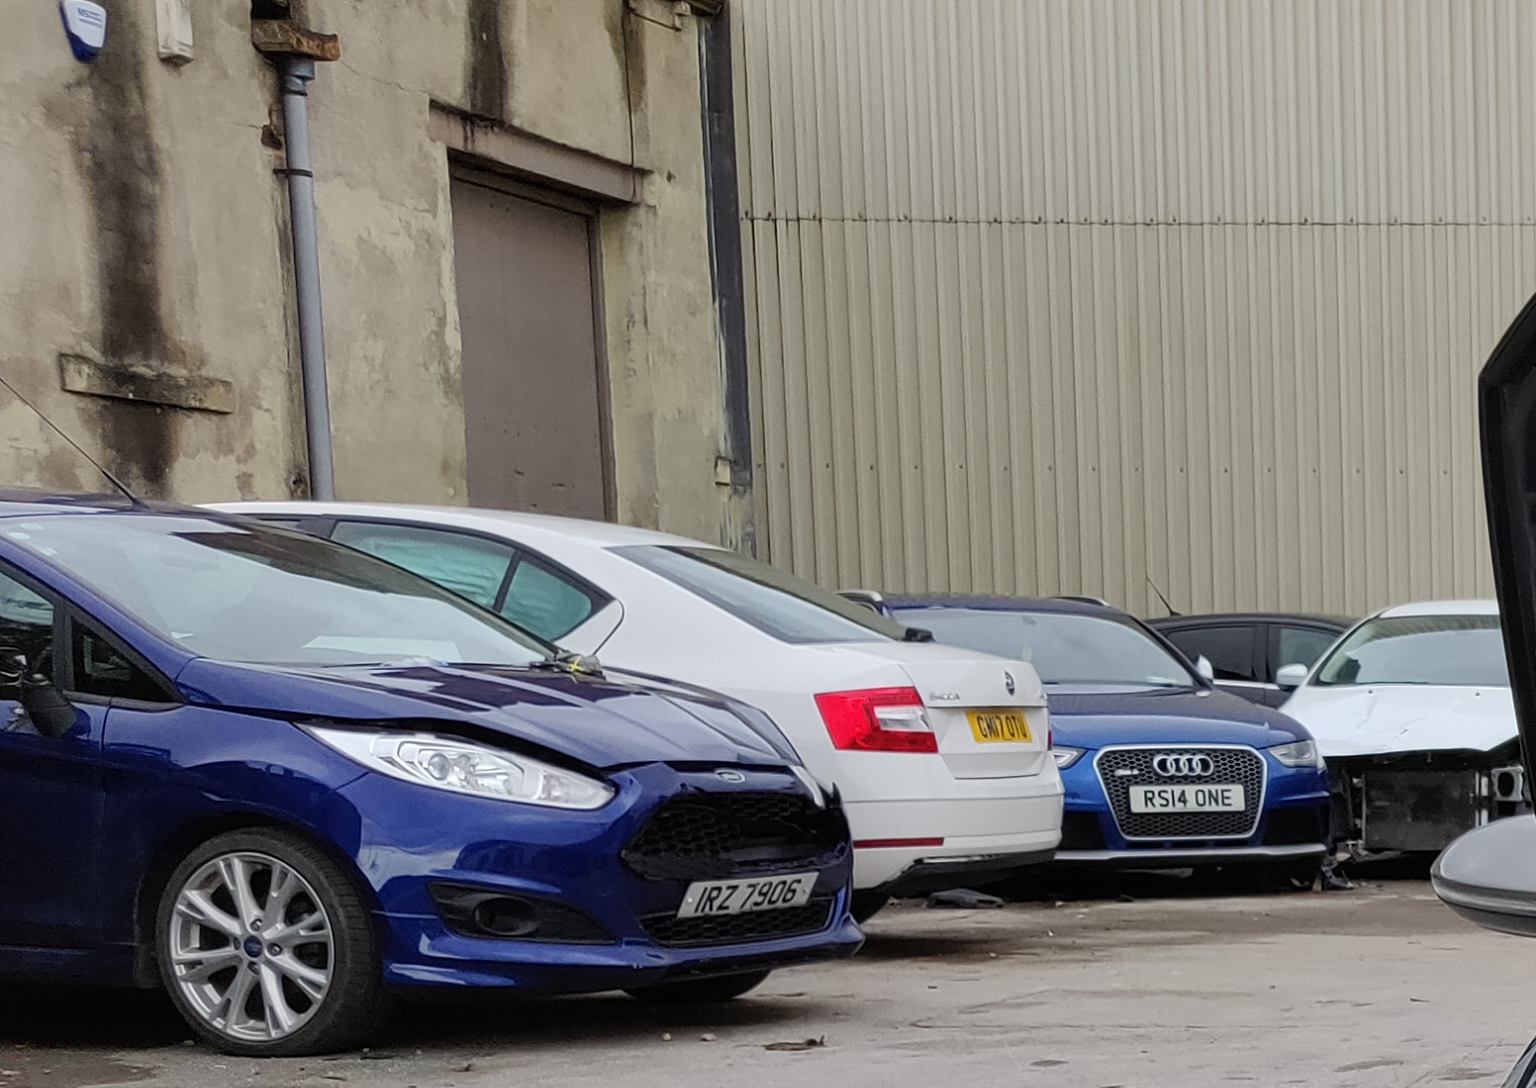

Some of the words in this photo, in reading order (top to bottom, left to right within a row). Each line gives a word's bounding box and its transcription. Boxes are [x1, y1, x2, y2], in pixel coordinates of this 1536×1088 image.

[1143, 789, 1188, 808] RS14
[1194, 788, 1233, 807] ONE
[693, 885, 740, 914] IRZ
[740, 878, 802, 909] 7906
